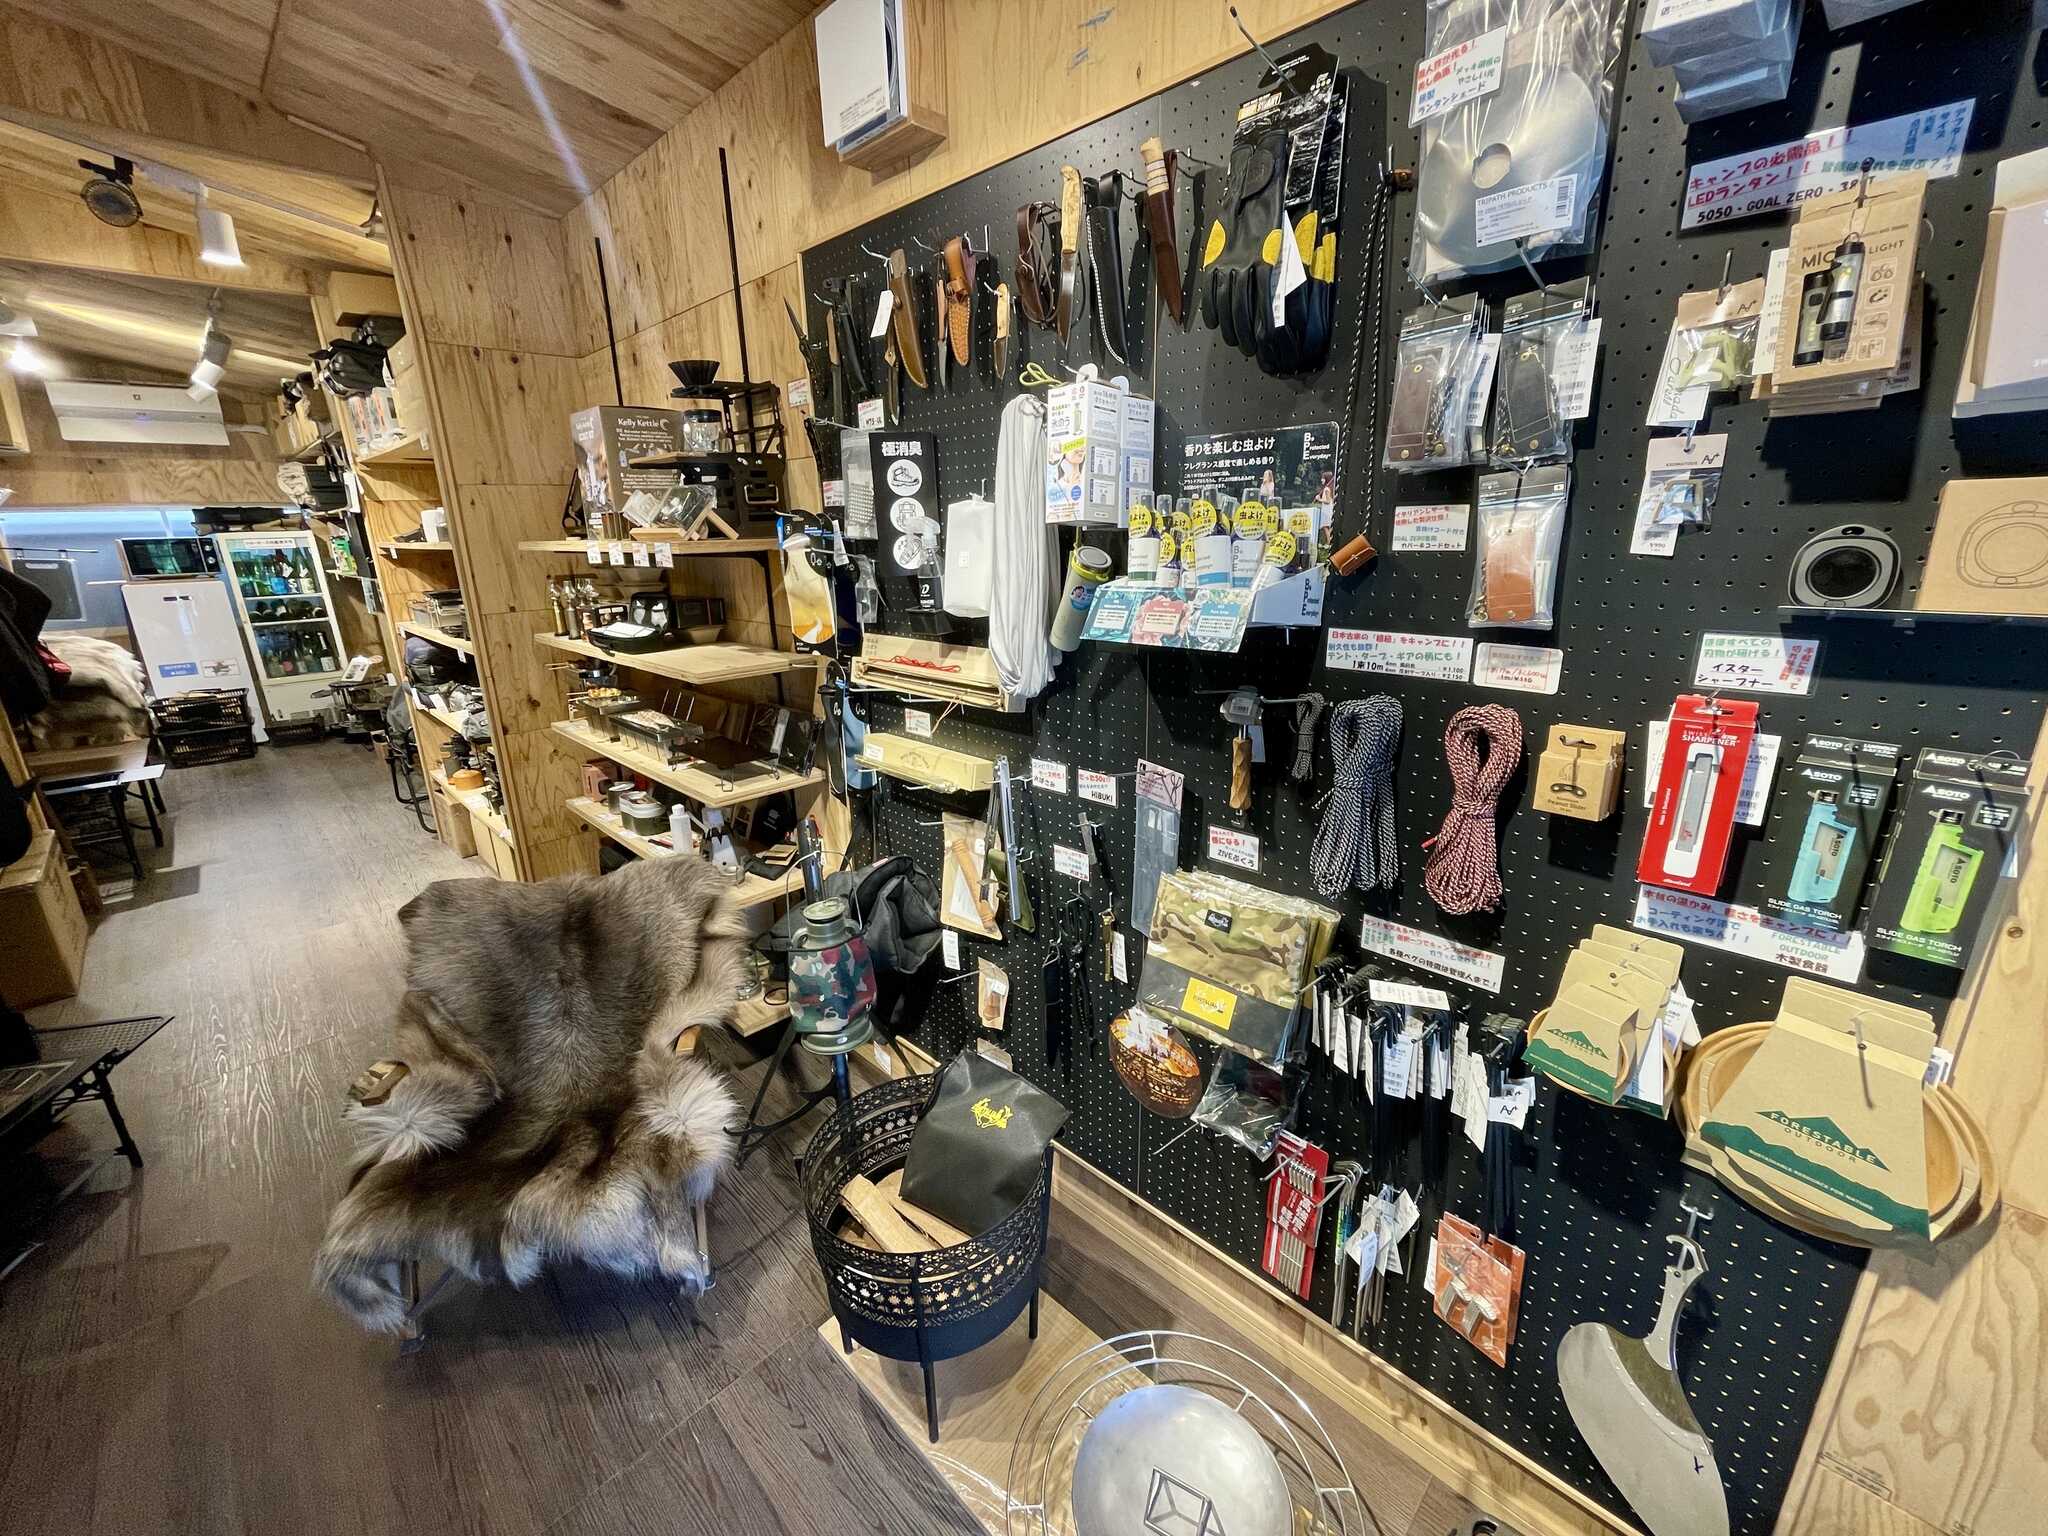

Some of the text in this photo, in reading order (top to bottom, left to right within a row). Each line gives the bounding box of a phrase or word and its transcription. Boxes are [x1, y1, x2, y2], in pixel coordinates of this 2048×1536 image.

[1507, 182, 1548, 198] PRODUCTS
[1746, 193, 1781, 212] GOAL
[1787, 186, 1823, 203] ZERO
[1868, 239, 1905, 255] LIGHT
[618, 418, 659, 428] Kelly Kettle
[881, 440, 923, 457] 極消臭
[1184, 437, 1276, 457] 香りを楽しむ虫よけ
[1183, 456, 1275, 470] フレグランス感覚で楽しめる香り
[1239, 511, 1264, 520] 虫よけ
[1712, 663, 1763, 673] イスター
[1697, 673, 1774, 687] シャープナー
[1681, 734, 1737, 747] SHARPENER
[1817, 739, 1844, 748] SOTO
[1937, 755, 1966, 765] SOTO
[1813, 771, 1843, 781] SOTO
[1091, 790, 1113, 802] HIBUKI
[1939, 789, 1971, 799] SOTO
[1768, 897, 1793, 909] SLIDE
[1792, 902, 1813, 913] GAS
[1813, 907, 1843, 920] TORCH
[1876, 927, 1963, 951] SLIDE GAS TORCH
[1779, 944, 1829, 961] OUTDOOR
[1775, 952, 1829, 974] 木製食器
[1770, 1112, 1876, 1164] FORESTABLE
[1784, 1127, 1857, 1163] OUTDOOR
